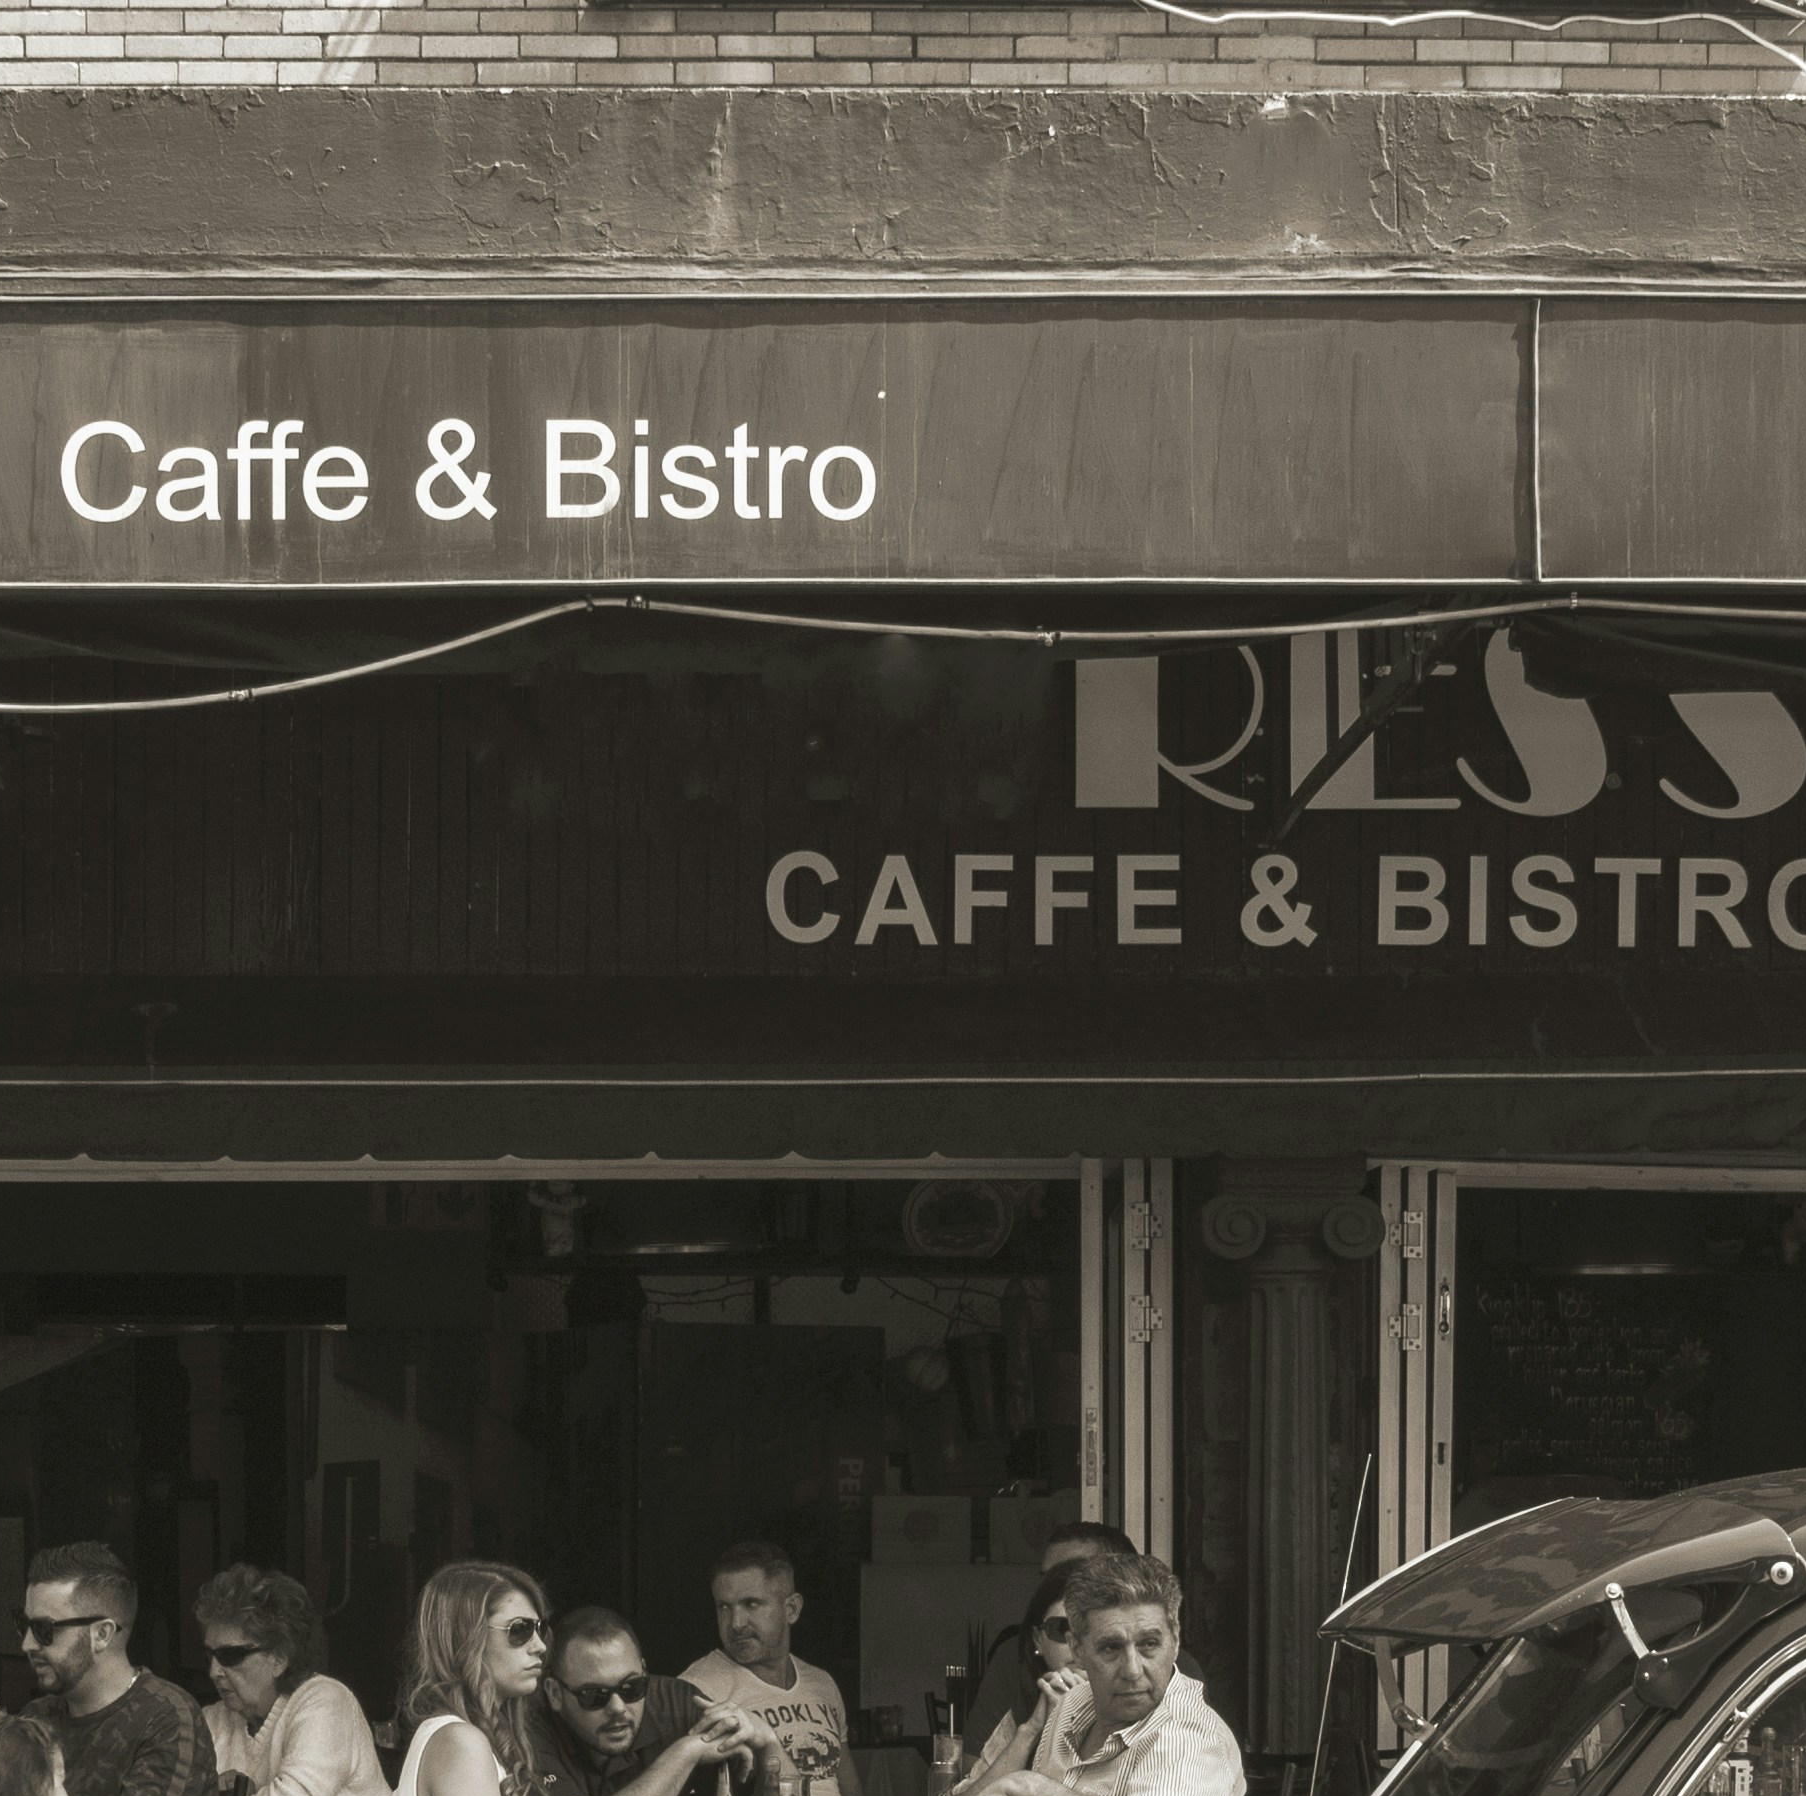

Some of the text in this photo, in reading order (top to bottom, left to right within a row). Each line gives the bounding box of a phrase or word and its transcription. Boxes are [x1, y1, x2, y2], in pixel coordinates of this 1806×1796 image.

[61, 418, 877, 523] Caffe & Bistro
[765, 851, 1183, 946] CAFFE
[1240, 853, 1319, 947] &
